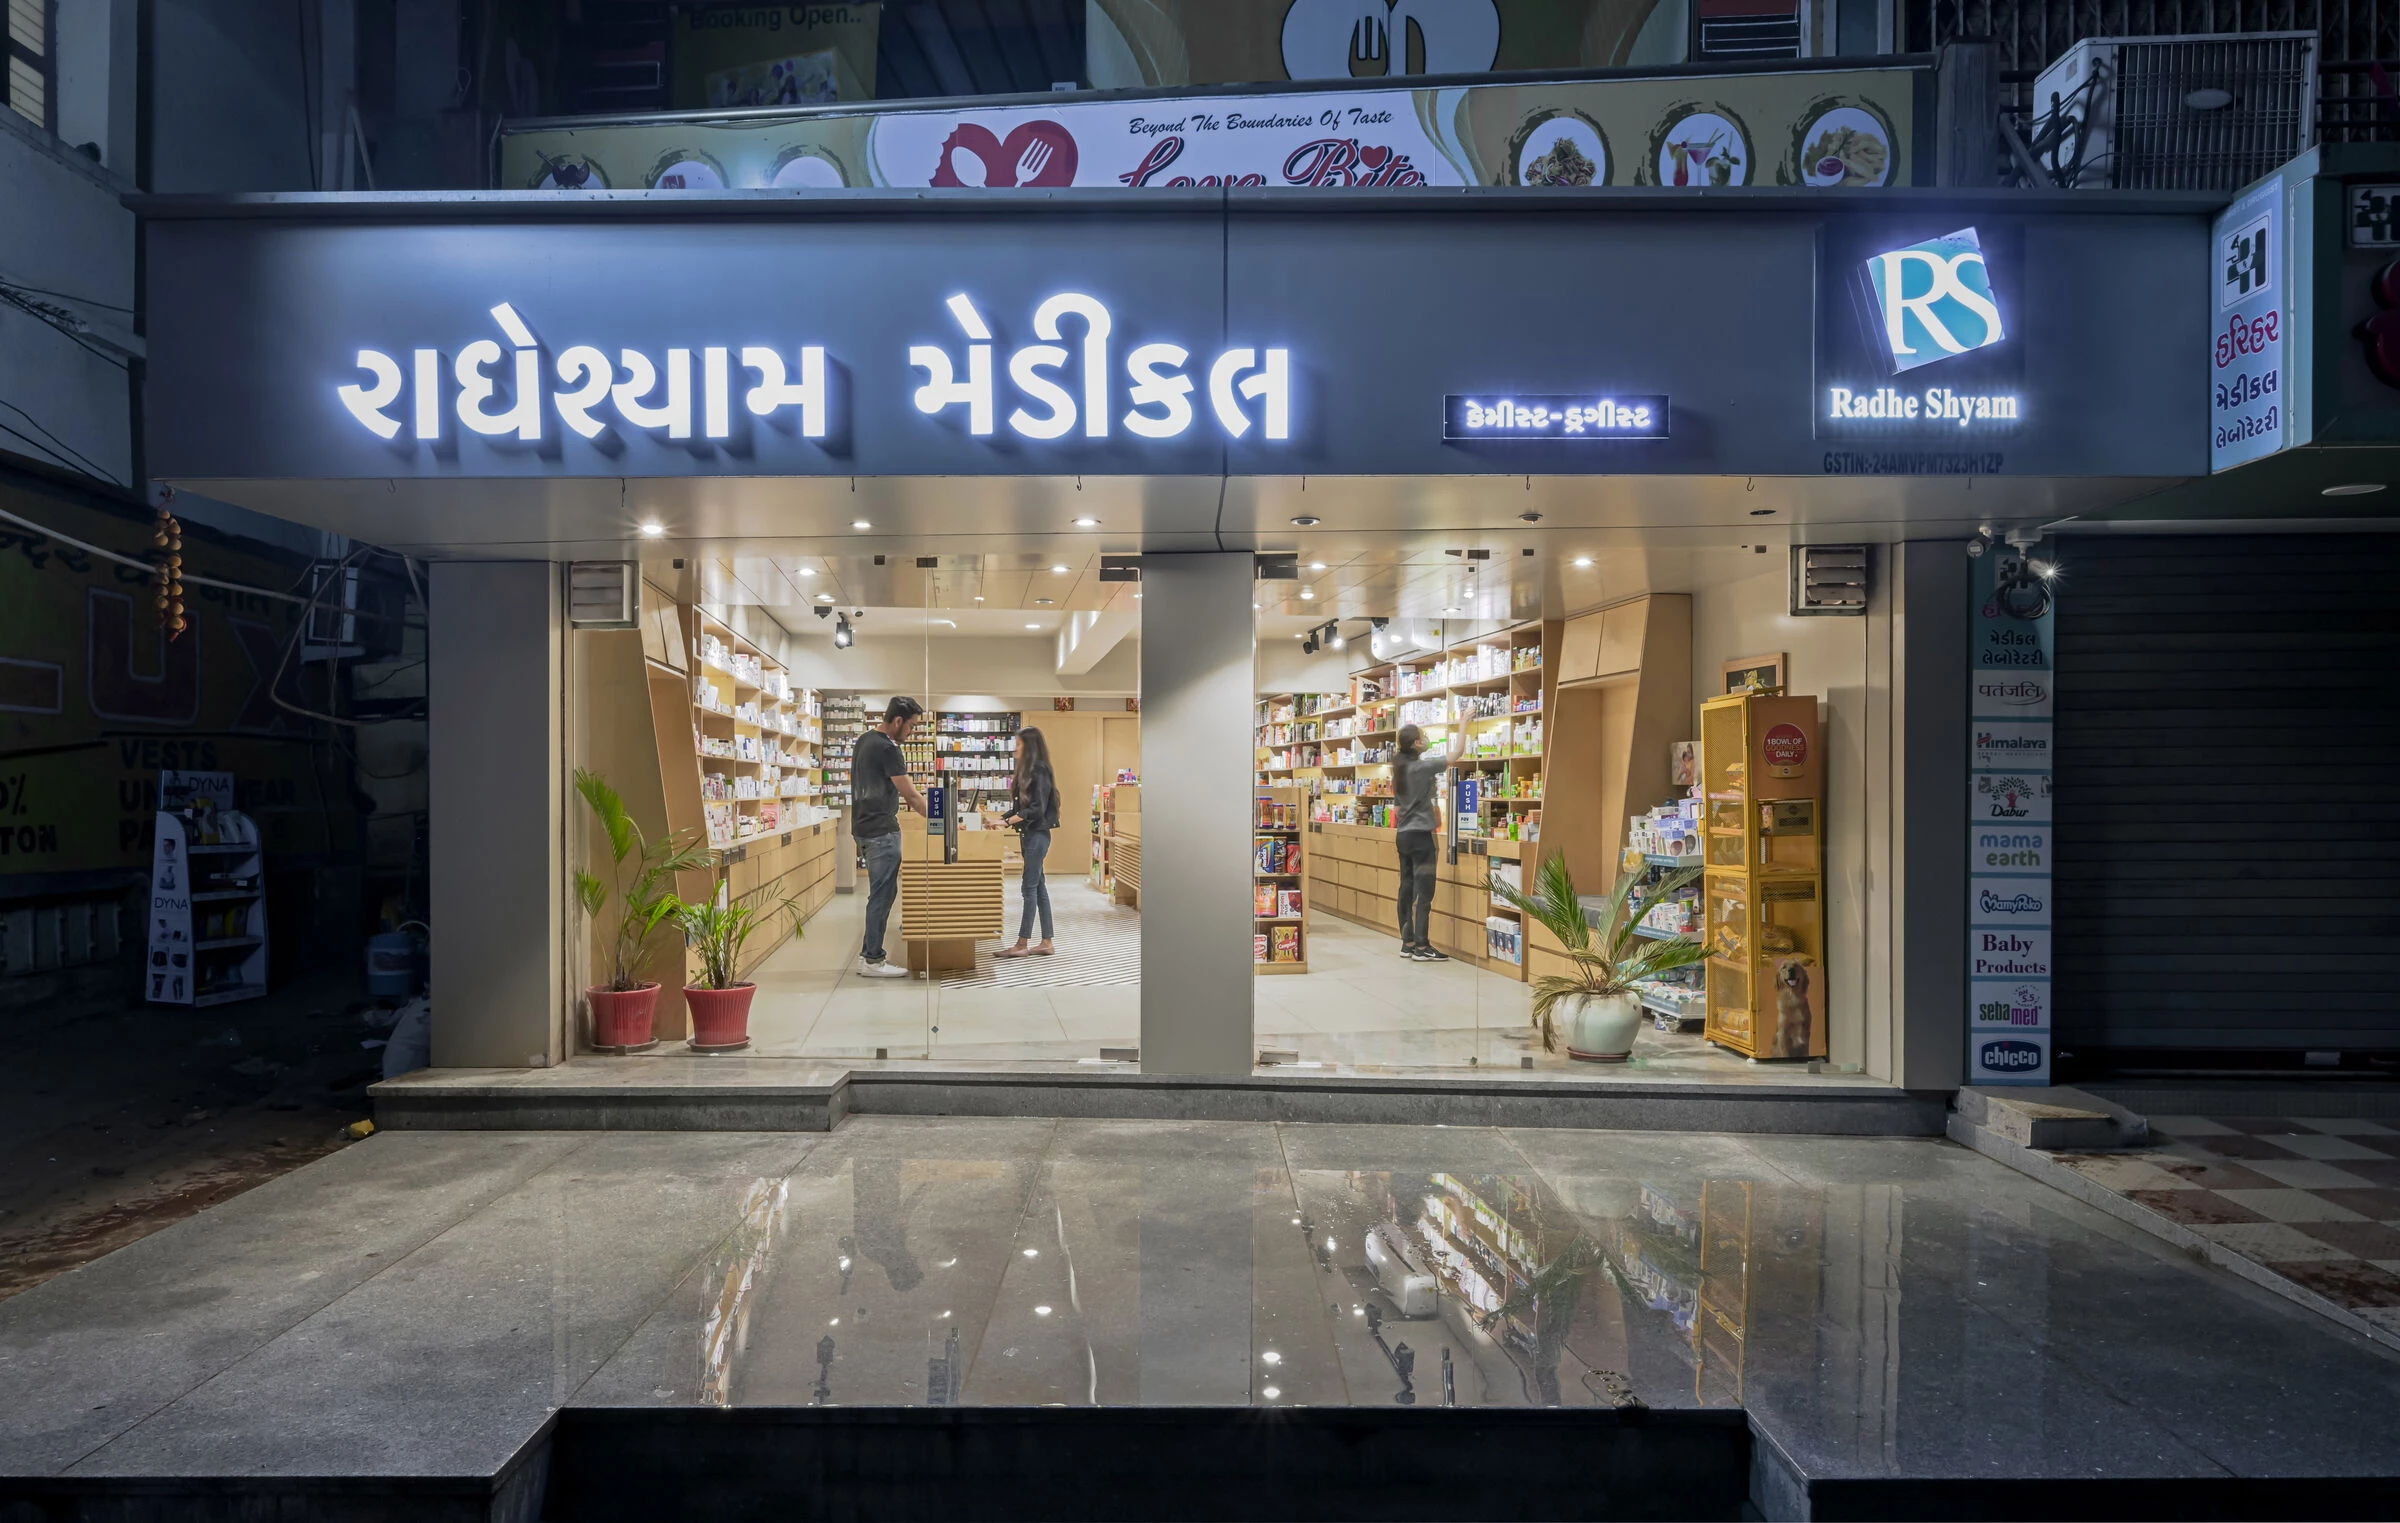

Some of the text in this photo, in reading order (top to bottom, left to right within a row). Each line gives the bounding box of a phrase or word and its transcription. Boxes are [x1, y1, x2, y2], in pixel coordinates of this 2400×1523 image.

[1129, 107, 1393, 137] Beyond The Boundaries Of Taste
[1880, 250, 2003, 354] RS
[2214, 310, 2280, 369] હરિહર
[337, 293, 1288, 440] રાધેશ્યામ મેડીકલ
[2215, 369, 2279, 411] મેડીકલ
[1830, 388, 2018, 427] Radhe Shyam
[2215, 405, 2279, 449] લેબોરેટરી
[1990, 629, 2036, 645] મેડીકલ
[1982, 649, 2043, 665] લેબોરેટરી
[1978, 681, 2041, 698] पतंजलि
[1976, 732, 2047, 749] Himalaya
[119, 739, 217, 771] VESTS
[188, 777, 229, 793] DYNA
[1990, 804, 2030, 818] Dabur
[1979, 834, 2043, 848] mama
[1986, 850, 2041, 866] earth
[154, 898, 189, 911] DYNA
[1982, 934, 2034, 957] Baby
[1975, 959, 2047, 974] Products
[1984, 1041, 2038, 1066] chicco
